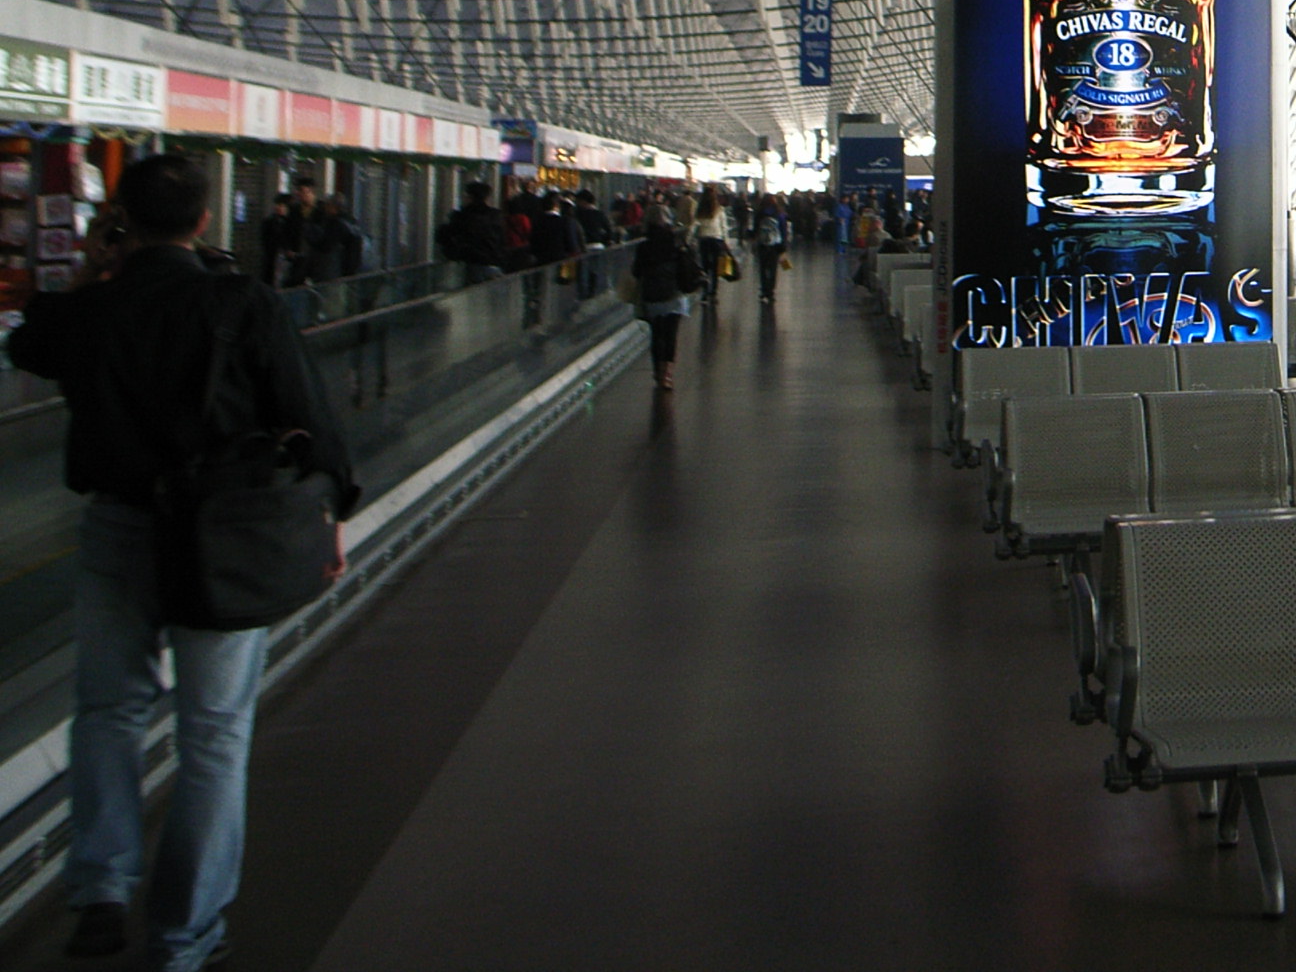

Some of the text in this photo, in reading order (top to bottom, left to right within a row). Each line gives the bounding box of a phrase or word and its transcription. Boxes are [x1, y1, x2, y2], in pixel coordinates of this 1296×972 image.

[802, 14, 830, 34] 20
[1056, 11, 1188, 43] CHIVAS REGAL
[1108, 43, 1136, 66] 18
[952, 269, 1274, 349] CHIVAS
